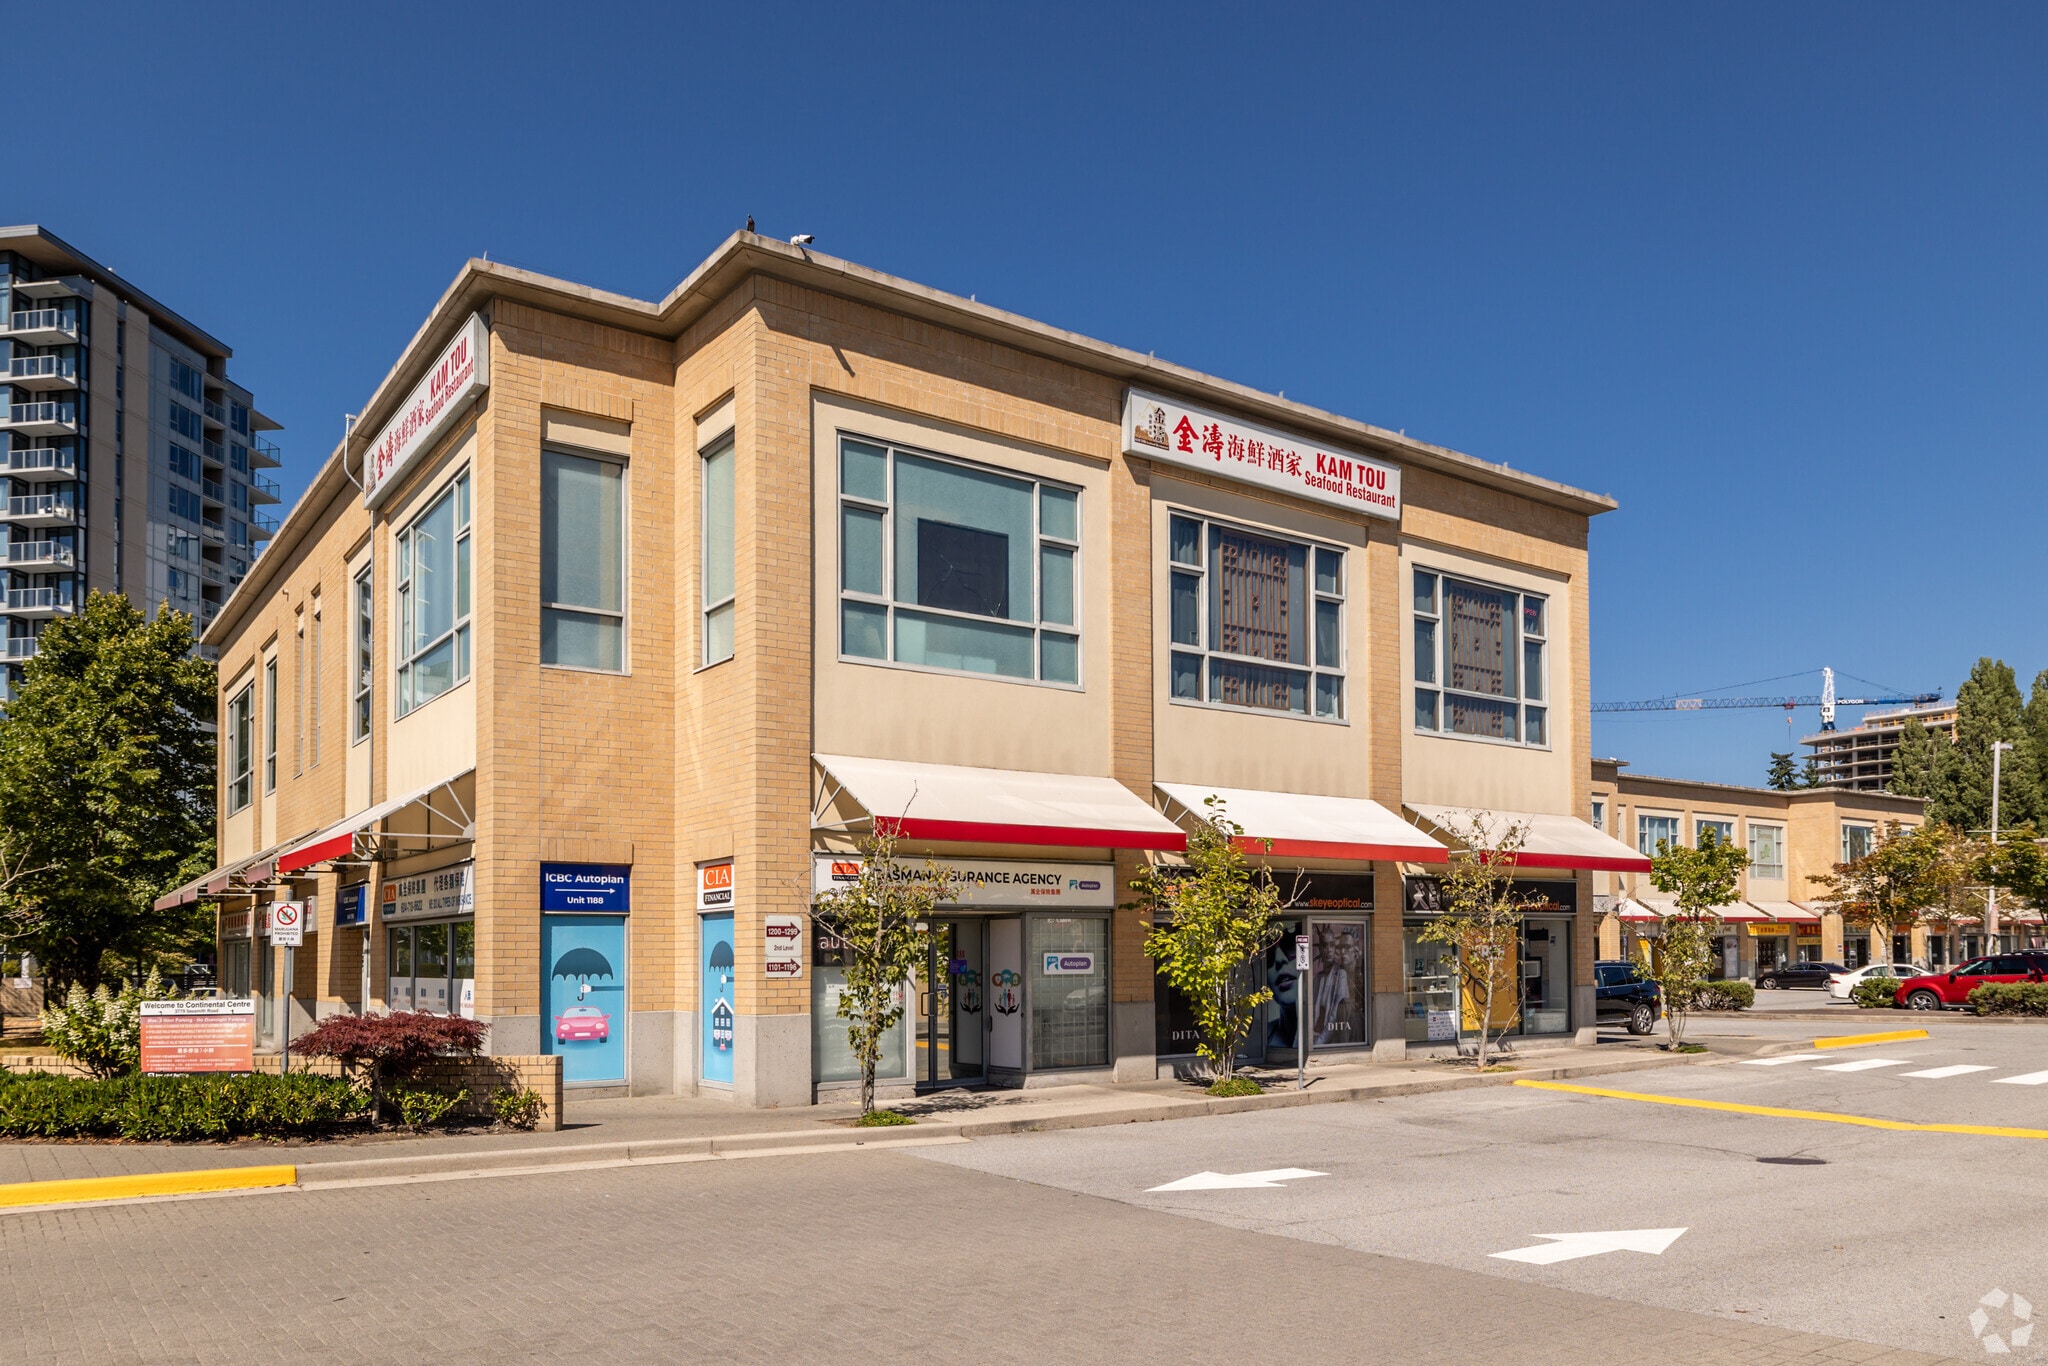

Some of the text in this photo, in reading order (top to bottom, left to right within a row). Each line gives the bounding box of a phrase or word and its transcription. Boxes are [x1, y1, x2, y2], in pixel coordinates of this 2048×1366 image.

[430, 336, 467, 401] KAM TOU
[425, 357, 474, 426] Seafood Restaurant
[1172, 414, 1303, 478] 金濤海鮮酒家
[1316, 452, 1386, 491] KAM TOU
[1304, 471, 1396, 509] Seafood Restaurant
[705, 868, 730, 886] CIA
[832, 865, 858, 874] CIA
[545, 872, 573, 883] ICBC
[937, 870, 1010, 884] SURANCE
[1012, 872, 1062, 886] AGENCY
[567, 896, 604, 905] Unit 1188
[704, 892, 731, 903] FINANCIAL
[1294, 896, 1374, 911] www.skeyeoptical.com
[1063, 960, 1088, 968] Autoplan
[1327, 1021, 1352, 1031] DITA
[1172, 1029, 1200, 1041] DITA
